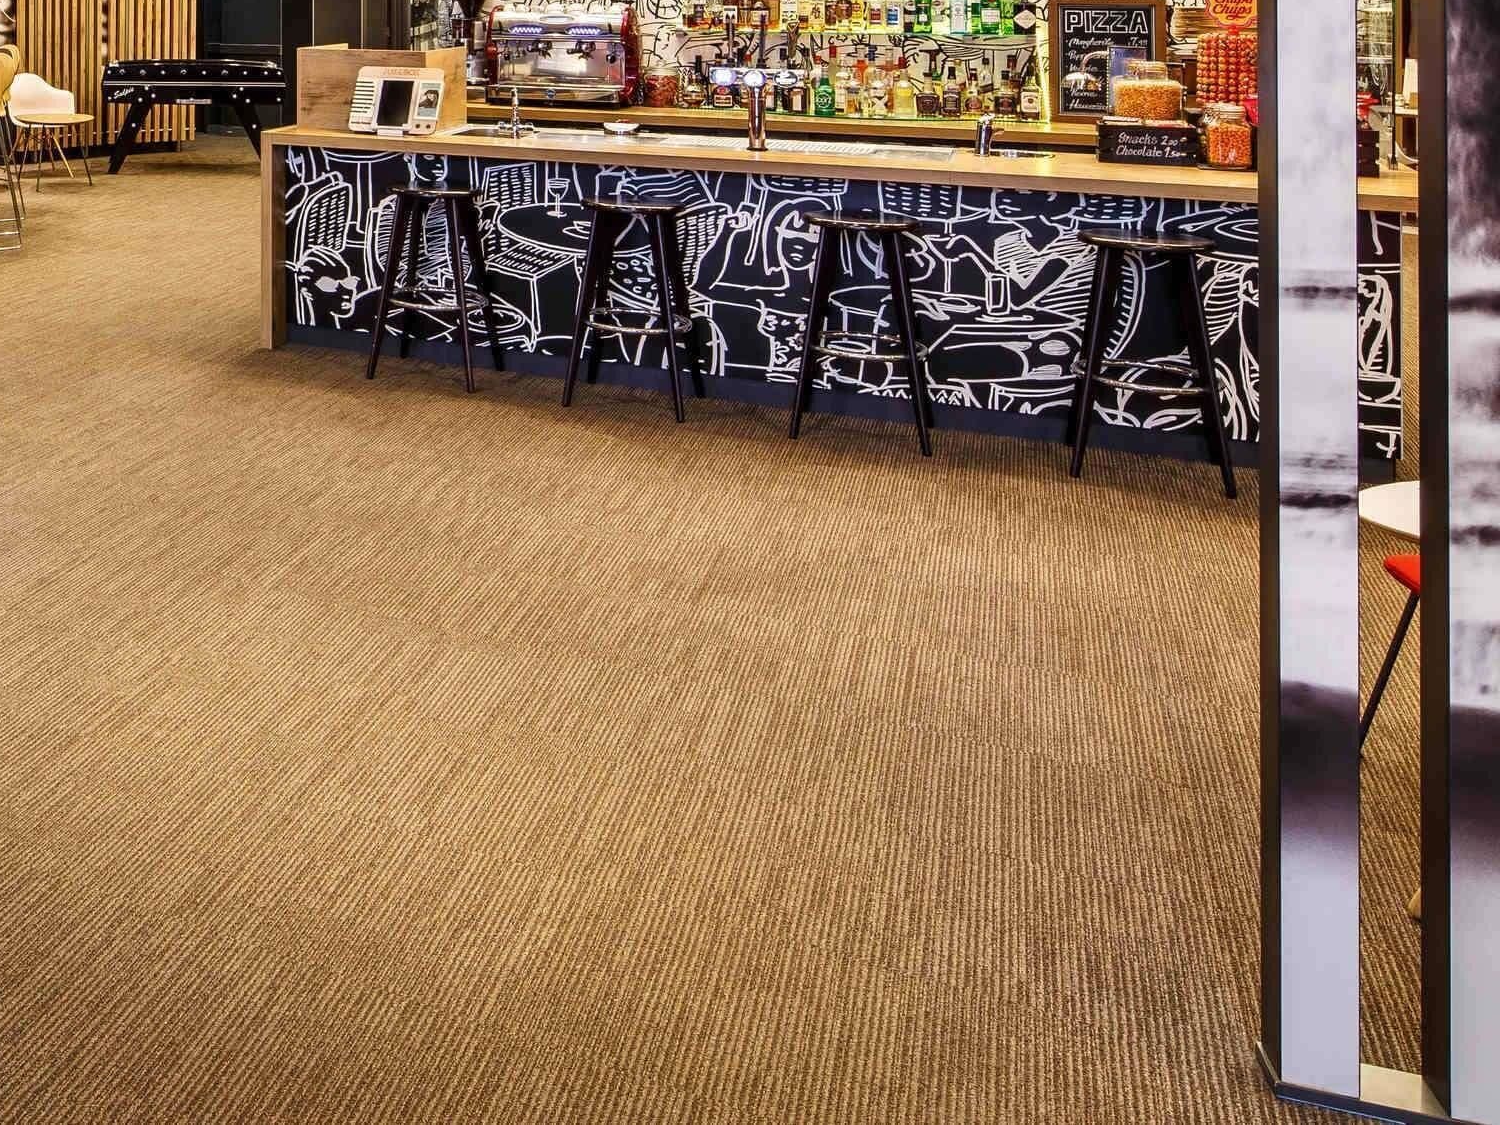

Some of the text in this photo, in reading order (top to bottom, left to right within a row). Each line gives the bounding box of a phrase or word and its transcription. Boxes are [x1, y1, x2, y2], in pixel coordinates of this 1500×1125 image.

[1212, 3, 1253, 21] Chups
[1064, 10, 1149, 34] PIZZA
[1118, 131, 1158, 145] Snacks
[1115, 145, 1163, 158] Chocolate
